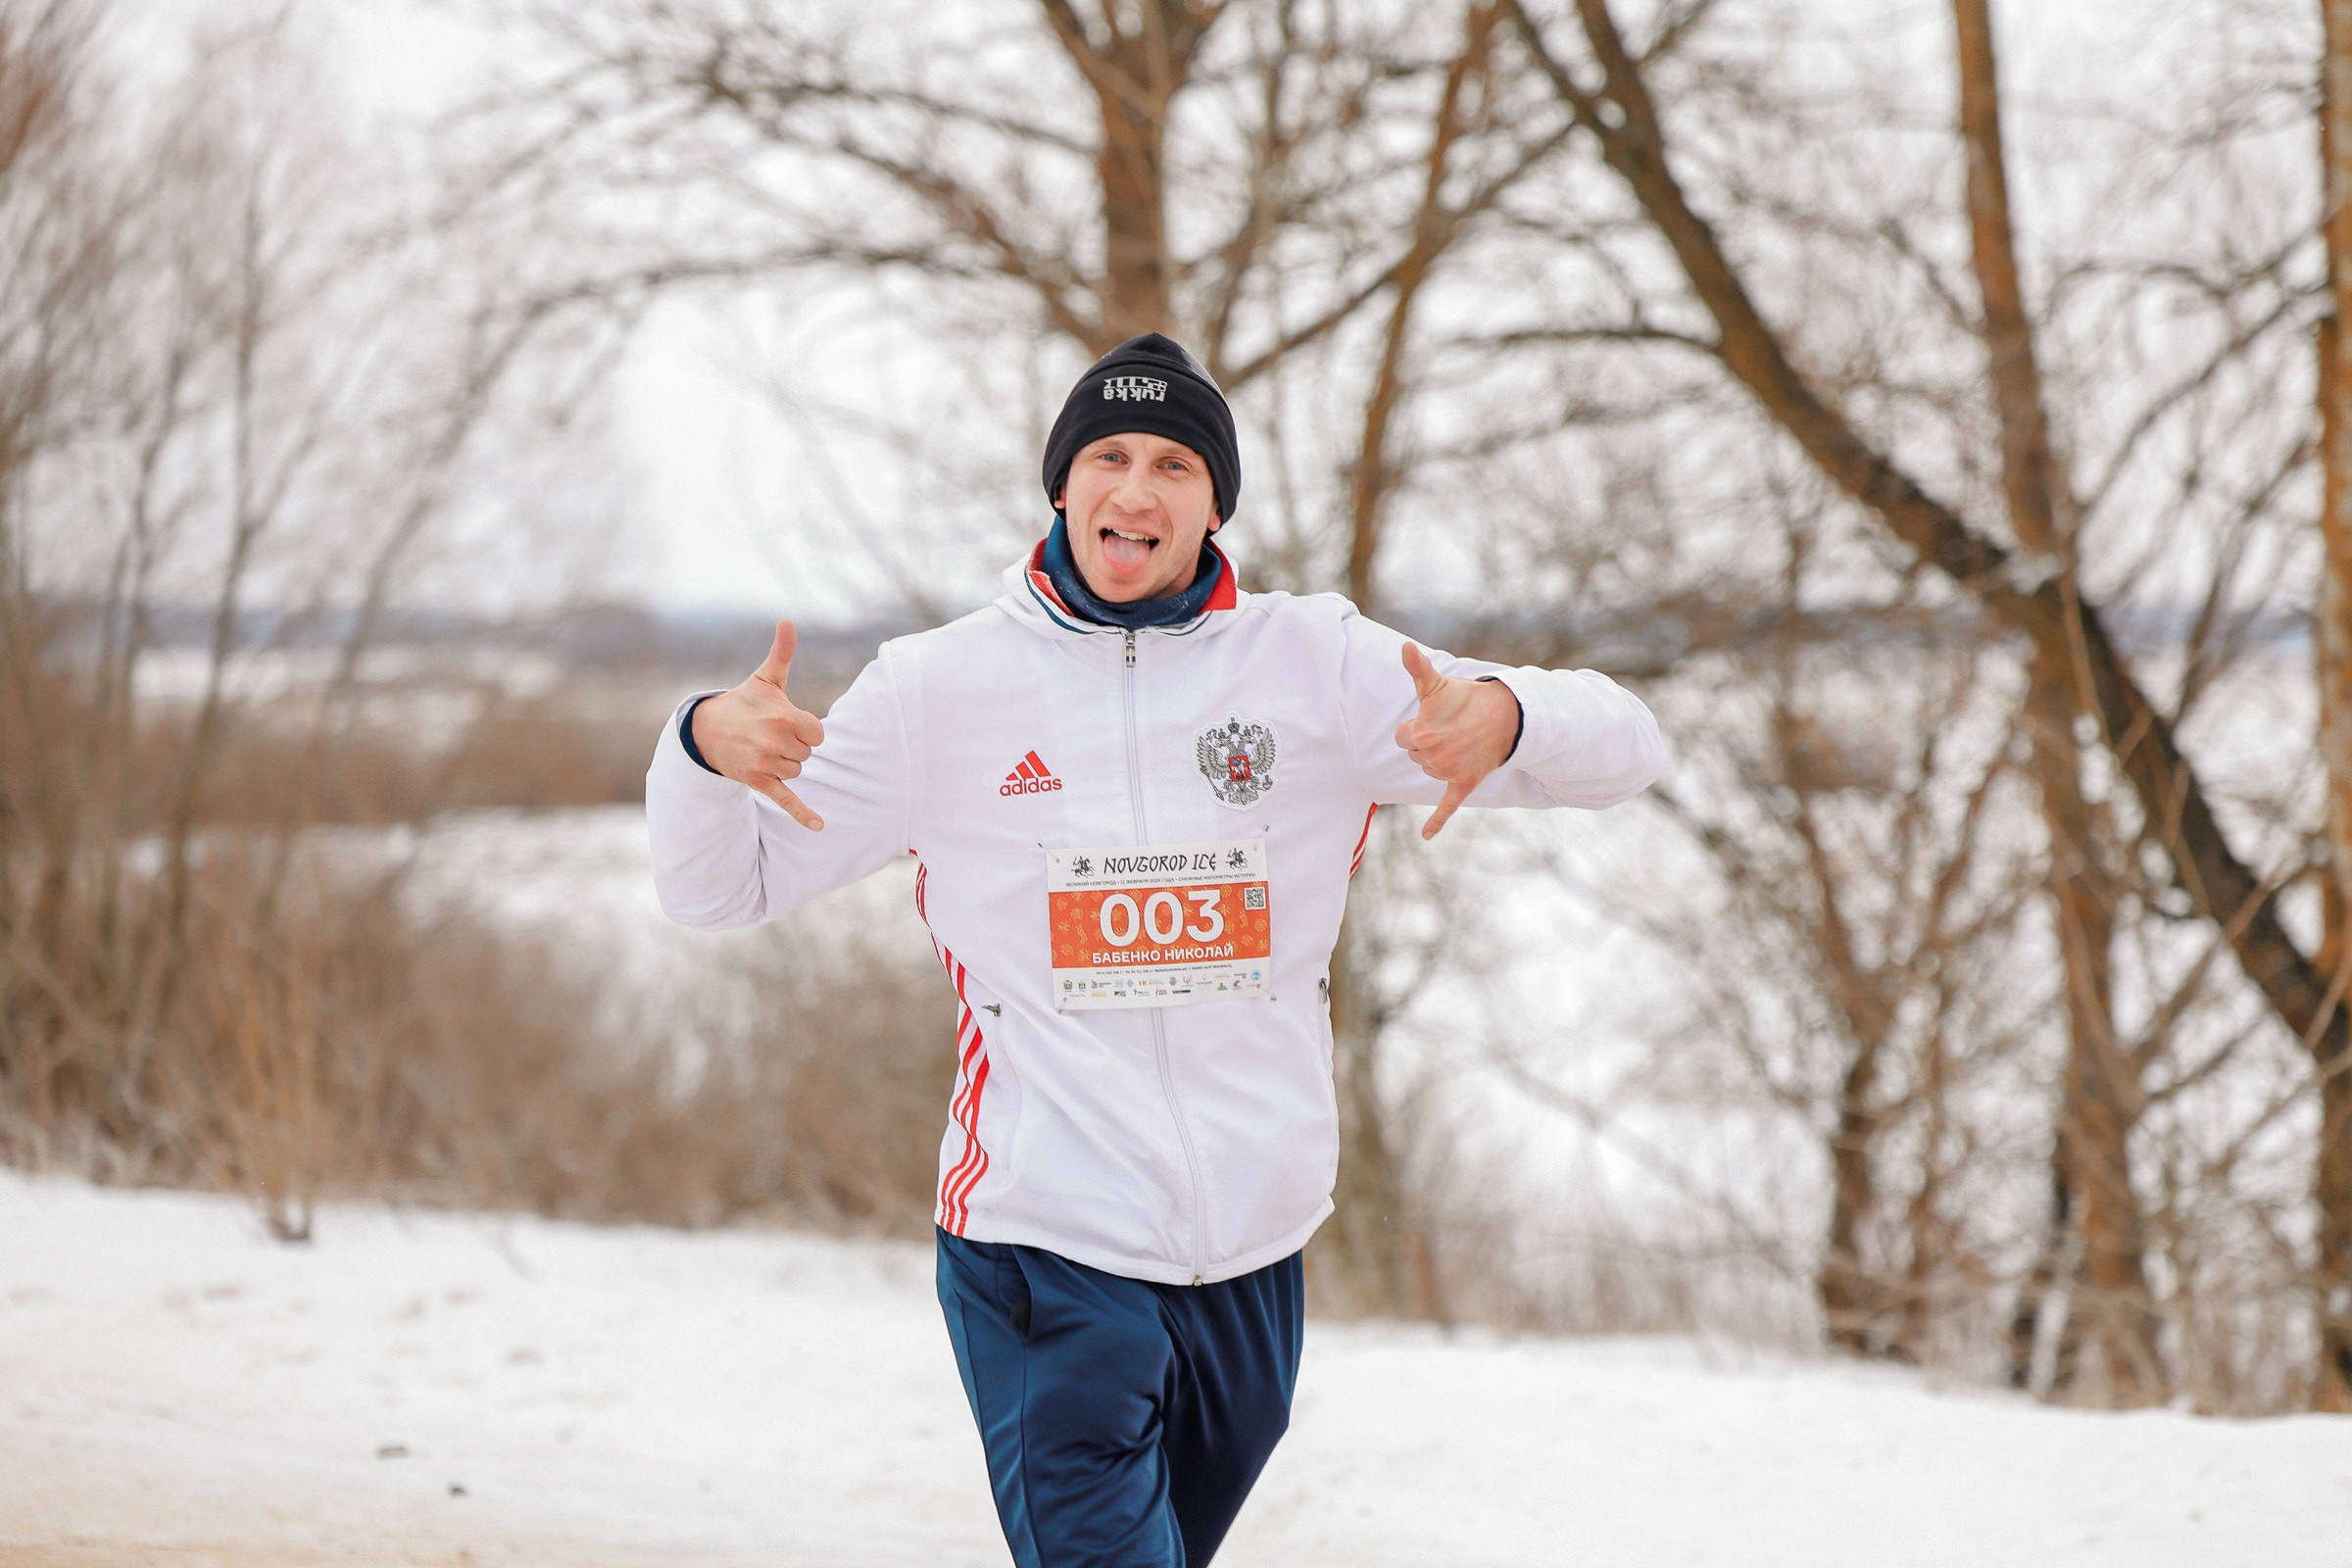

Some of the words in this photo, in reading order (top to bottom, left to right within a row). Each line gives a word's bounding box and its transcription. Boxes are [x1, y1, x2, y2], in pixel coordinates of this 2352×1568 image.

[1103, 387, 1165, 402] rukka
[1000, 777, 1062, 796] adidas
[1103, 855, 1187, 874] NOVGOROD
[1192, 853, 1217, 871] ICE
[1100, 890, 1225, 948] 003
[1093, 950, 1160, 963] БАБЕНКО
[1164, 943, 1234, 960] НИКОЛАЙ
